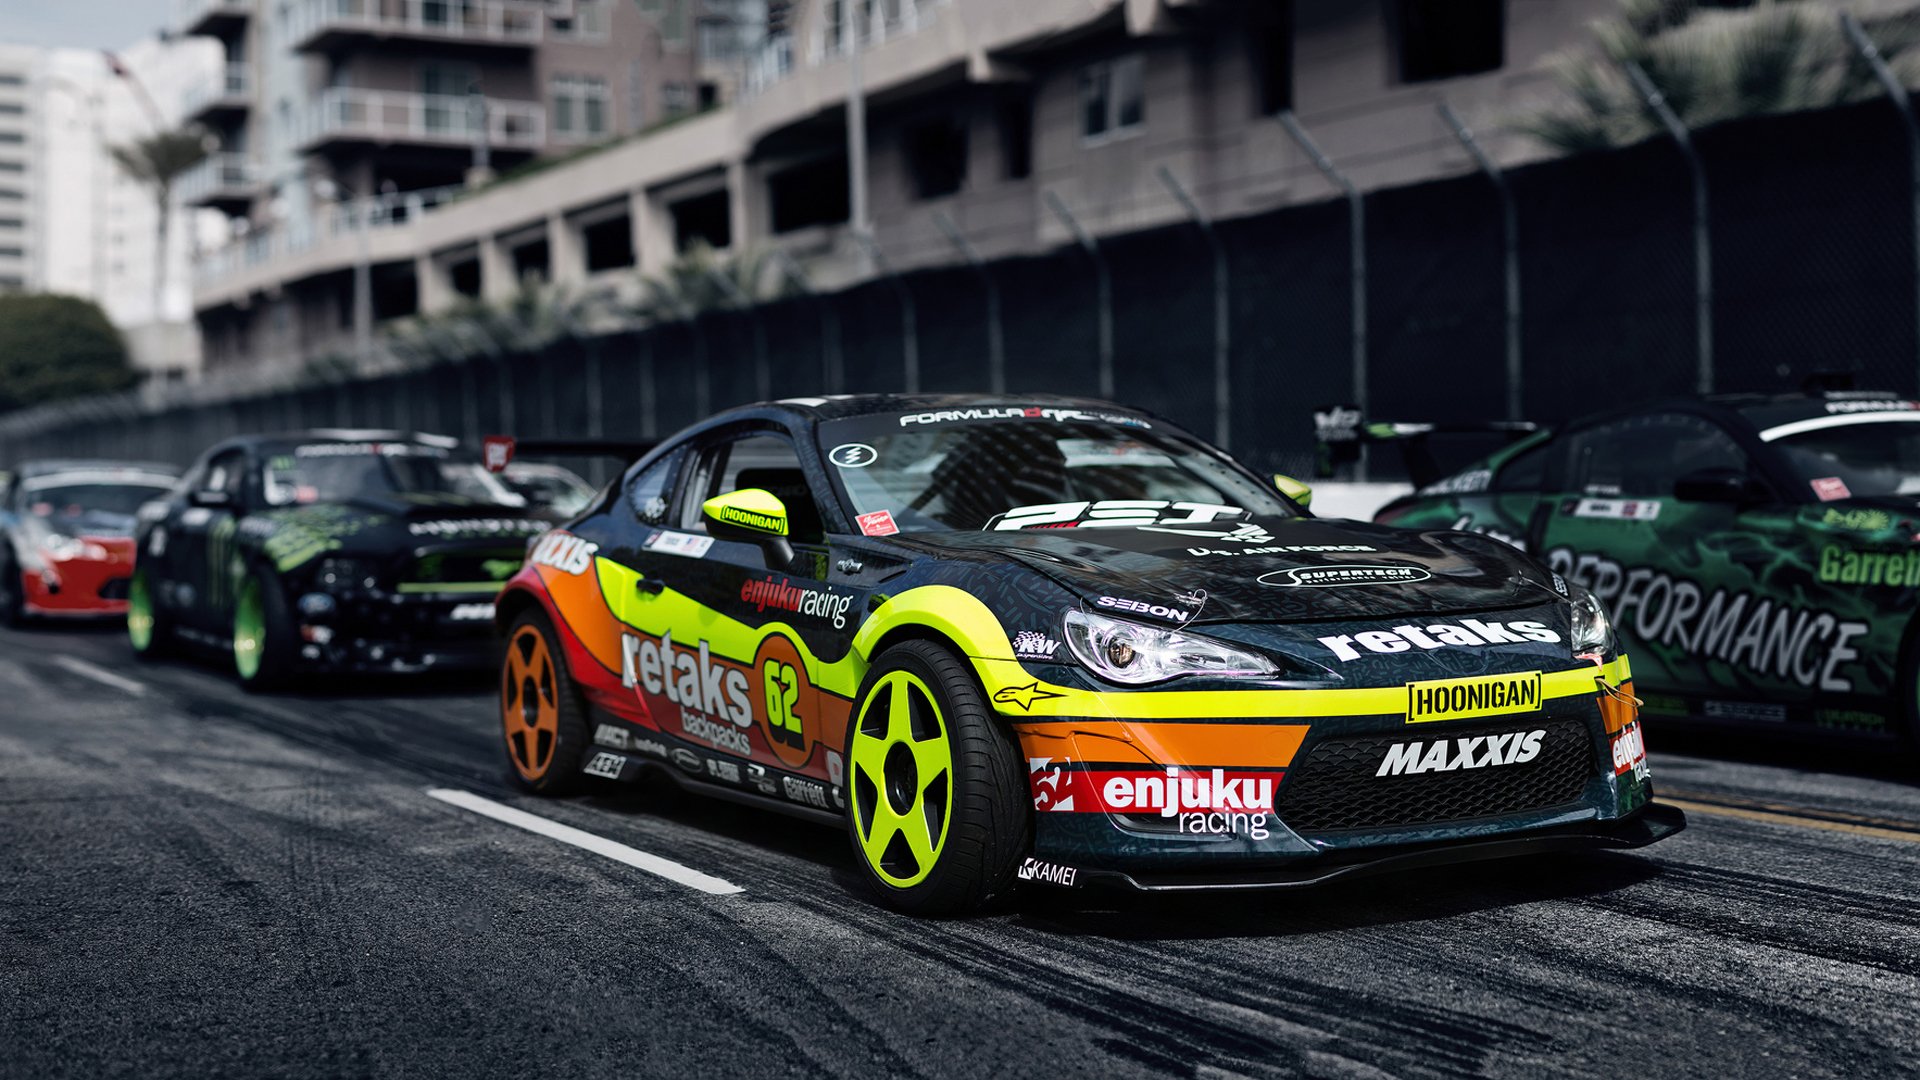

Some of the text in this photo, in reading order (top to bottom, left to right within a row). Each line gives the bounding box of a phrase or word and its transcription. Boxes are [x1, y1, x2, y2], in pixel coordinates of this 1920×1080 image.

[1243, 546, 1289, 555] AIR
[1299, 568, 1413, 580] SUPERTECH
[1096, 595, 1190, 622] SEBON
[1017, 638, 1062, 656] KW
[1317, 618, 1562, 663] retaks
[622, 628, 752, 728] retaks
[763, 659, 803, 736] 62
[680, 704, 751, 756] backpacks
[1375, 729, 1547, 778] MAXXIS
[1103, 767, 1272, 818] enjuku
[1178, 807, 1270, 840] racing
[1031, 862, 1077, 887] KAMEI
